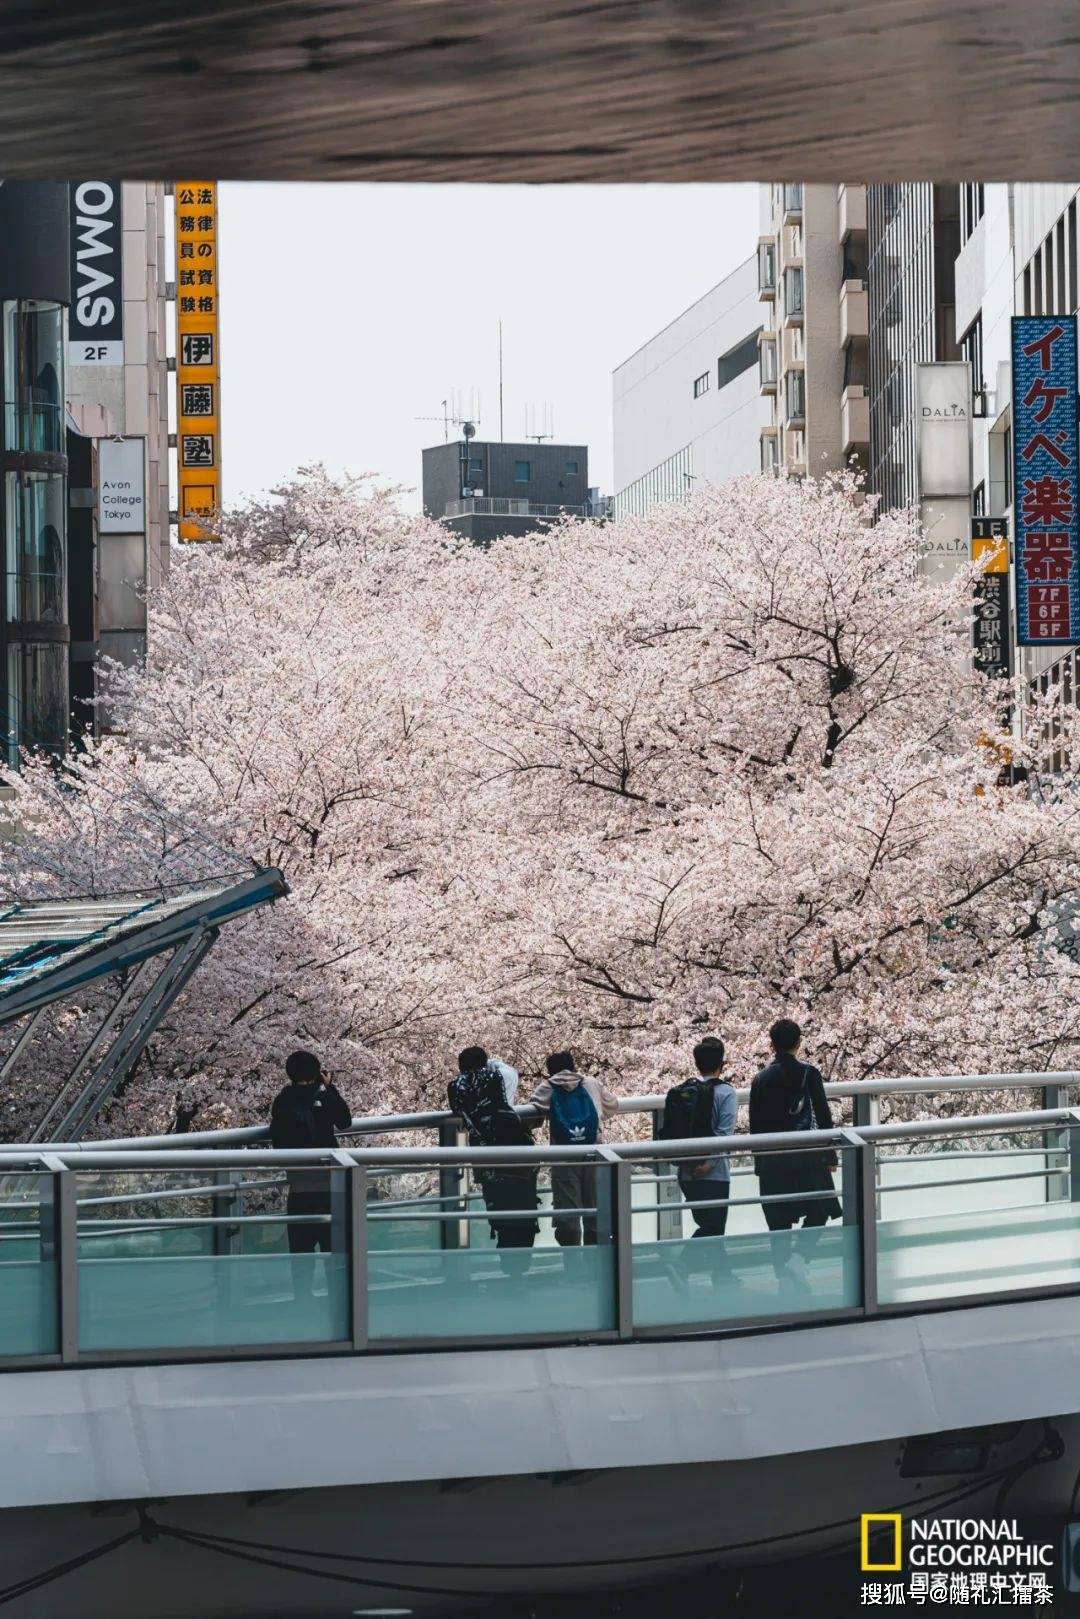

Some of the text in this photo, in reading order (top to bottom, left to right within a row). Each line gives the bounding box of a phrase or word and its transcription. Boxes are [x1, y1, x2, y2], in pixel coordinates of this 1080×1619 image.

[75, 180, 115, 327] SVWO
[179, 188, 196, 313] 公務員試験
[197, 188, 213, 313] 法律の資格
[84, 347, 108, 361] 2F
[182, 334, 214, 467] 伊藤塾
[1021, 324, 1073, 582] イケベ楽器
[102, 481, 131, 490] Avon
[102, 495, 142, 505] College
[104, 510, 131, 519] Tokyo
[976, 522, 1002, 536] 1F
[1038, 588, 1060, 602] 7F
[1038, 605, 1061, 619] 6F
[1039, 623, 1061, 637] 5F
